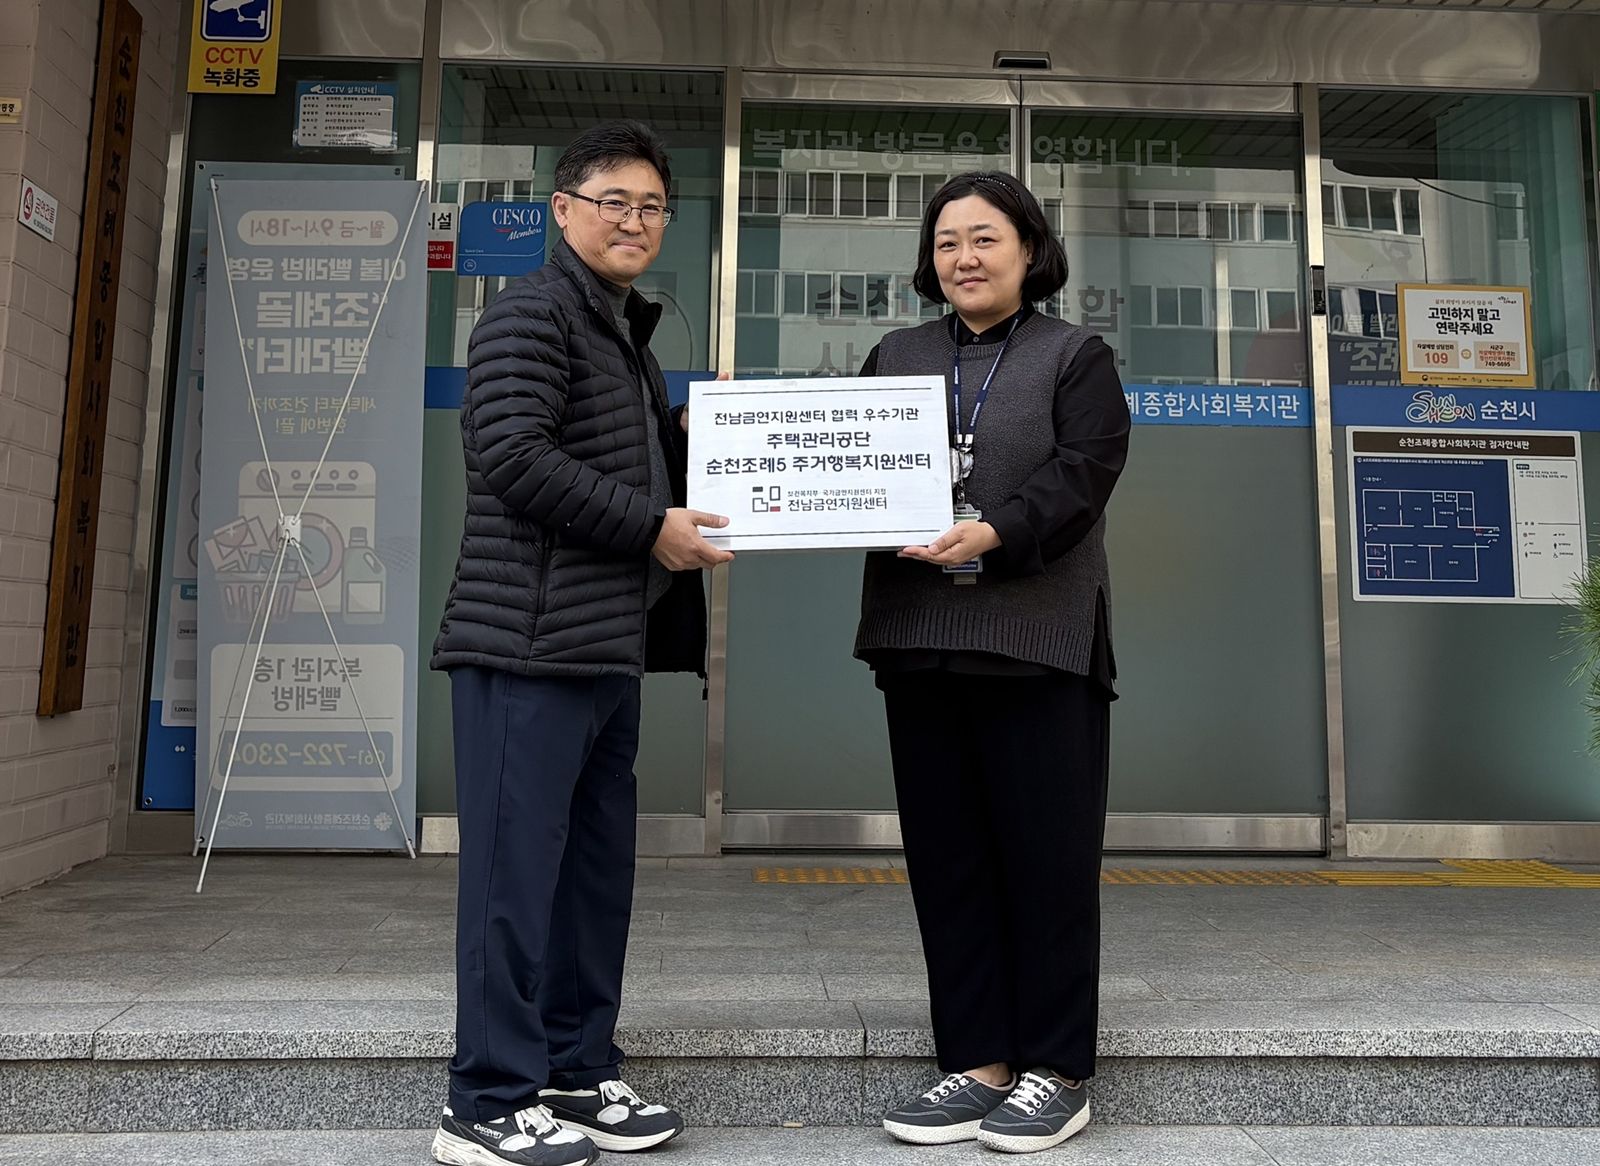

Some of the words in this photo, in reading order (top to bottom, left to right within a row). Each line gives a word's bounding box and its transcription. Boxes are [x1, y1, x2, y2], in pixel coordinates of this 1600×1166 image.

[205, 47, 264, 65] CCTV
[203, 67, 261, 88] 녹화중
[347, 86, 375, 94] 설치안내
[752, 128, 861, 170] 복지관
[873, 130, 985, 171] 방문을
[492, 208, 541, 226] CESCO
[507, 227, 542, 241] Members
[1428, 307, 1474, 321] 고민하지
[1477, 308, 1501, 321] 말고
[1435, 321, 1494, 335] 연락주세요
[1424, 352, 1449, 364] 109
[714, 409, 826, 425] 전남금연지원센터
[831, 408, 858, 422] 협력
[863, 407, 920, 422] 우수기관
[1480, 400, 1536, 421] 순천시
[767, 431, 871, 449] 주택관리공단
[1399, 437, 1486, 449] 순천조례종합사회복지관
[1489, 440, 1529, 450] 점자안내판
[706, 457, 787, 475] 순천조례5
[792, 453, 932, 473] 주거행복지원센터
[787, 496, 887, 511] 전남금연지원센터
